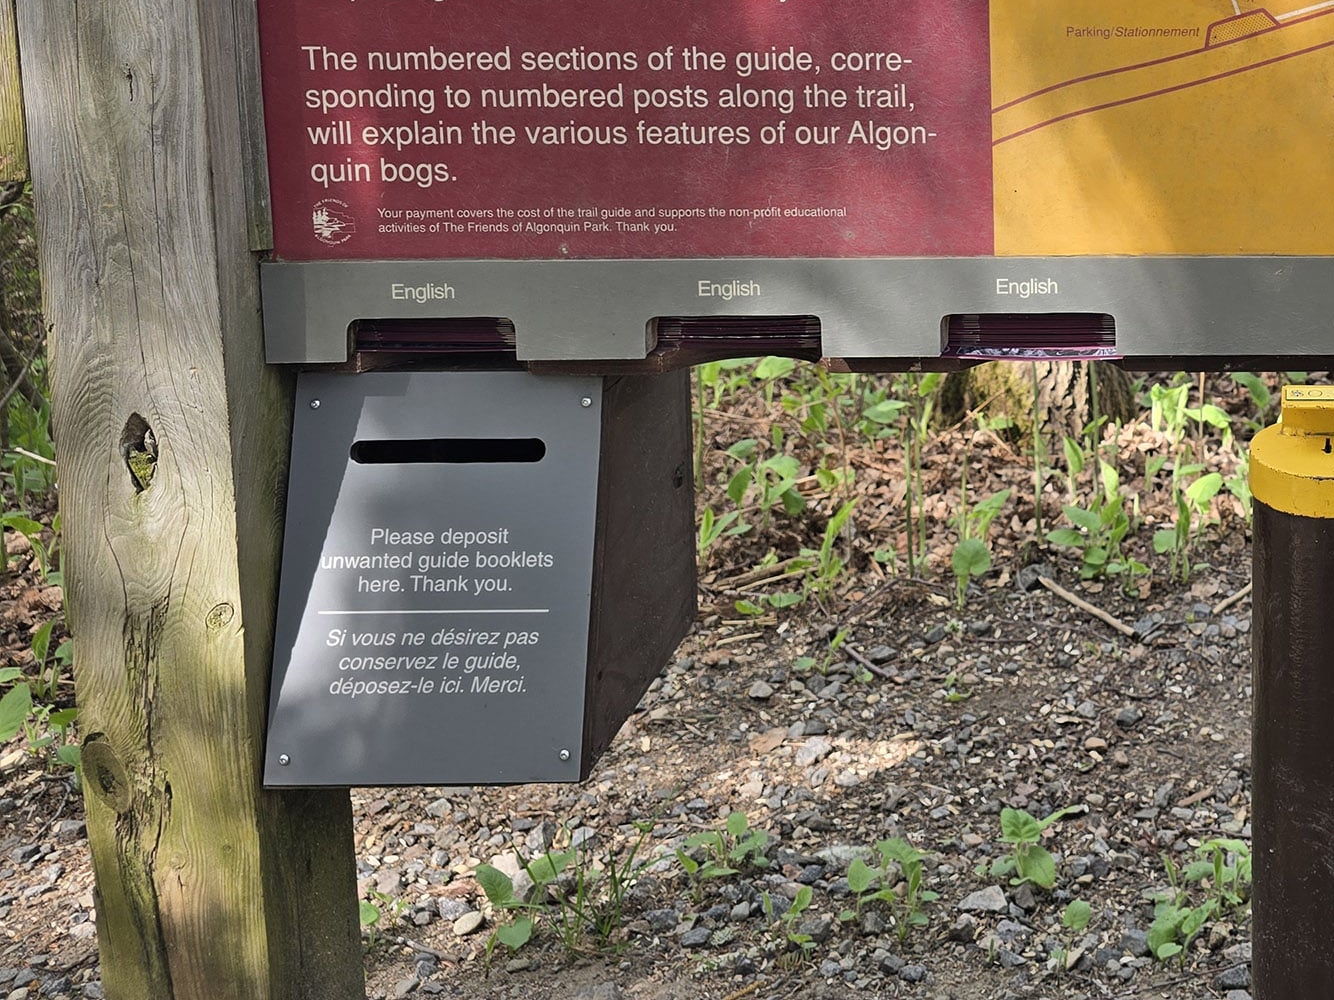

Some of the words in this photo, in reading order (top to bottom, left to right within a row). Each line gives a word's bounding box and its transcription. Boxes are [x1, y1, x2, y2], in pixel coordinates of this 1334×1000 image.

[1066, 26, 1200, 40] Parking/Stationnement
[306, 83, 435, 114] sponding
[444, 85, 471, 108] to
[481, 83, 623, 108] numbered
[634, 85, 708, 114] posts
[719, 83, 794, 113] along
[803, 83, 847, 108] the
[856, 84, 914, 111] trail,
[377, 207, 403, 218] Your
[406, 208, 454, 220] payment
[456, 209, 494, 218] covers
[496, 207, 514, 217] the
[517, 208, 540, 217] cost
[543, 207, 554, 217] of
[557, 207, 575, 217] the
[577, 207, 598, 217] trail
[601, 207, 631, 219] guide
[634, 207, 655, 217] and
[658, 208, 706, 219] supports
[708, 207, 726, 217] the
[729, 207, 781, 219] non-profit
[784, 207, 846, 217] educational
[378, 222, 426, 233] activities
[429, 222, 440, 232] of
[442, 222, 464, 232] The
[468, 222, 509, 232] Friends
[512, 222, 522, 232] of
[525, 222, 580, 234] Algonquin
[584, 221, 612, 232] Park.
[615, 221, 650, 232] Thank
[654, 223, 677, 233] you.
[392, 283, 455, 303] English
[698, 280, 760, 300] English
[996, 278, 1058, 298] English
[371, 528, 434, 545] Please
[441, 528, 509, 548] deposit
[321, 551, 412, 569] unwanted
[418, 551, 469, 572] guide
[476, 551, 553, 568] booklets
[358, 576, 404, 592] here.
[410, 575, 468, 592] Thank
[474, 579, 512, 596] you.
[327, 629, 347, 646] Si
[352, 633, 396, 646] vous
[401, 632, 425, 645] ne
[431, 628, 501, 645] désirez
[503, 631, 539, 649] pas
[339, 656, 438, 670] conservez
[442, 652, 459, 669] le
[464, 652, 520, 673] guide,
[329, 676, 434, 698] déposez-le
[439, 676, 464, 693] ici.
[470, 676, 526, 693] Merci.
